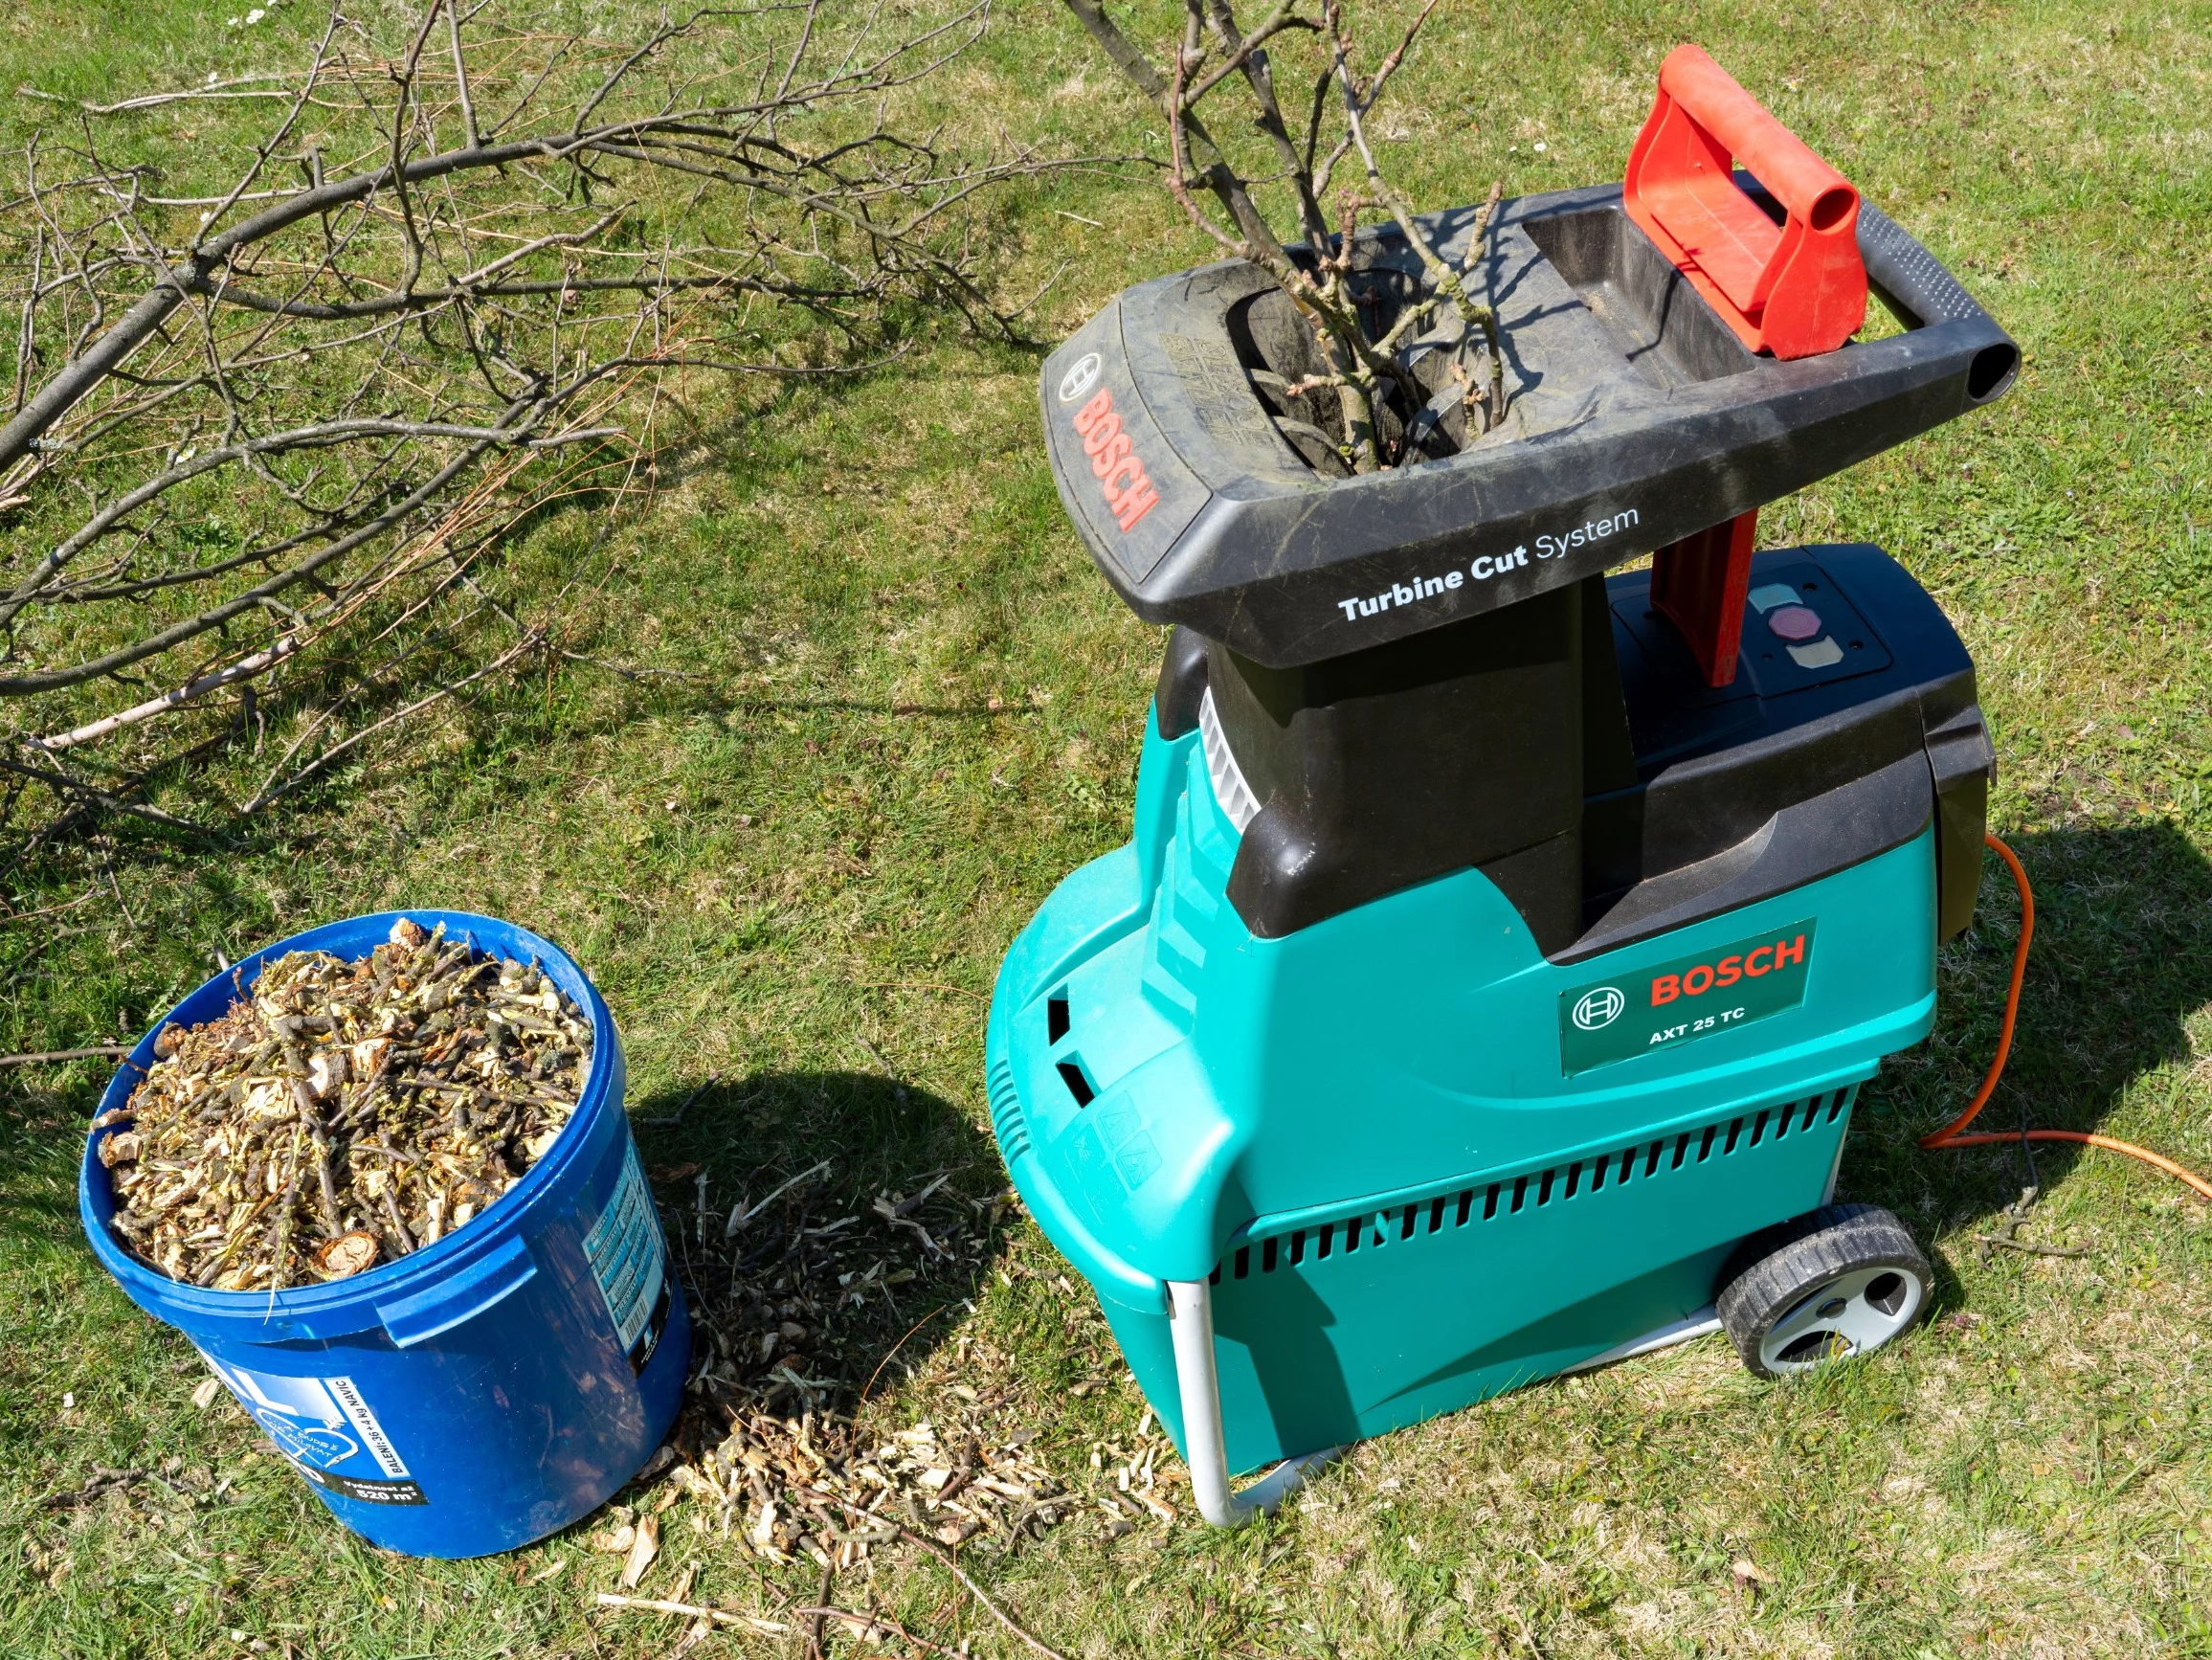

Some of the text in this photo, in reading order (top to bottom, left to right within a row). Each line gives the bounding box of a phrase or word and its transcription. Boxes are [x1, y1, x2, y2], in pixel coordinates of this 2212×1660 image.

[1073, 387, 1160, 533] BOSCH
[1337, 508, 1639, 621] Turbine Cut System
[1650, 934, 1805, 1007] BOSCH
[1649, 1007, 1745, 1044] AXT 25 TC
[355, 1489, 390, 1500] 520
